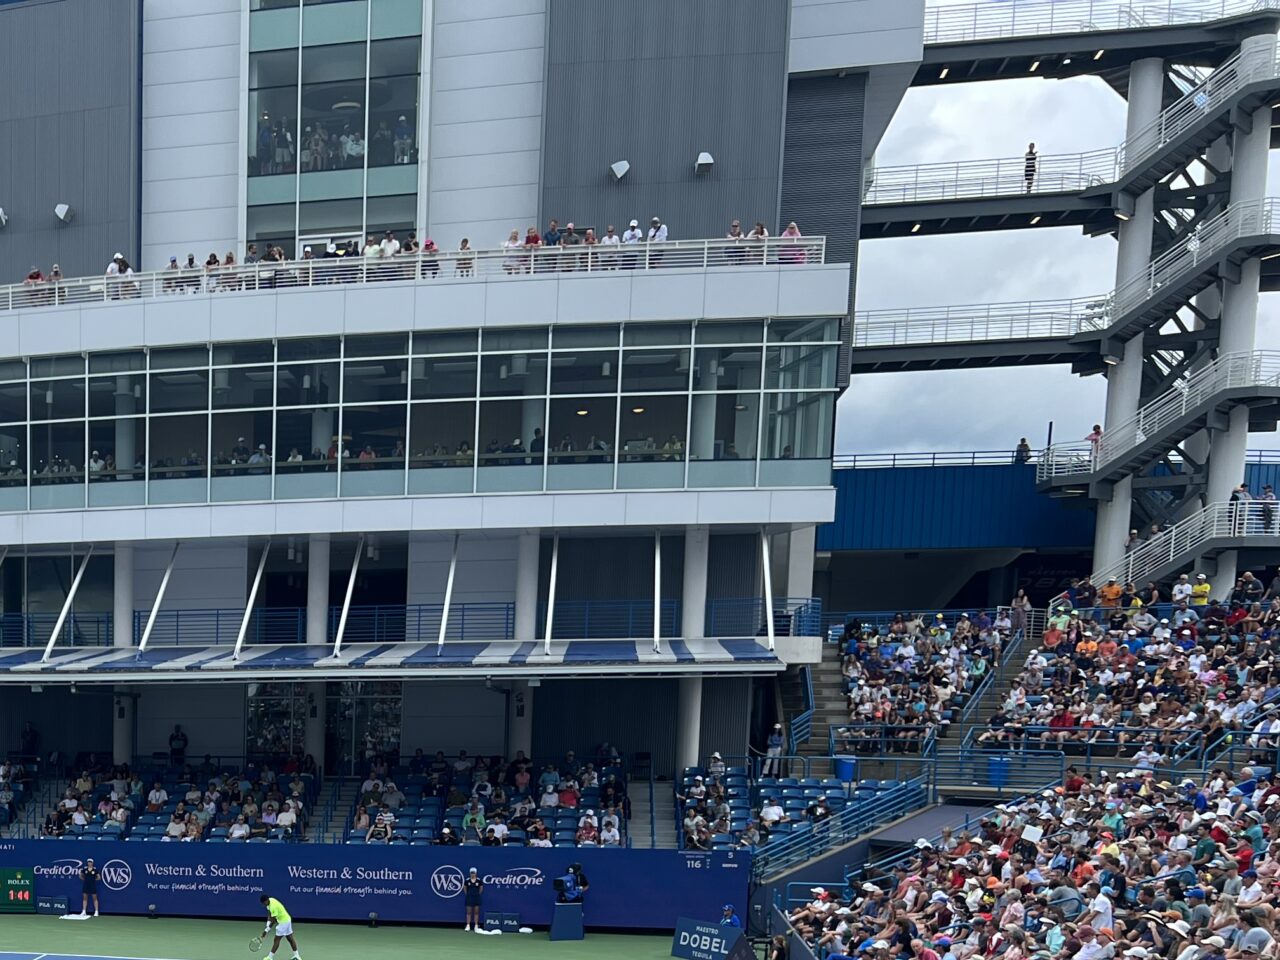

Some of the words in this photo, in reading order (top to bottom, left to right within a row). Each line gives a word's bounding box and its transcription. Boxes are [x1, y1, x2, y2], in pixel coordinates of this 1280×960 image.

[686, 860, 702, 868] 116
[144, 863, 192, 876] Western
[195, 864, 207, 877] &
[210, 864, 264, 878] Southern
[288, 865, 337, 880] Western
[340, 866, 353, 880] &
[356, 867, 413, 881] Southern
[147, 882, 158, 890] Put
[171, 882, 197, 892] financial
[198, 882, 225, 894] strength
[226, 884, 249, 892] behind
[289, 885, 301, 893] Put
[315, 885, 342, 895] financial
[343, 886, 373, 898] strength
[373, 887, 397, 895] behind
[695, 926, 719, 935] MAESTRO
[679, 931, 729, 954] DOBEL
[692, 950, 713, 960] TEQUILA
